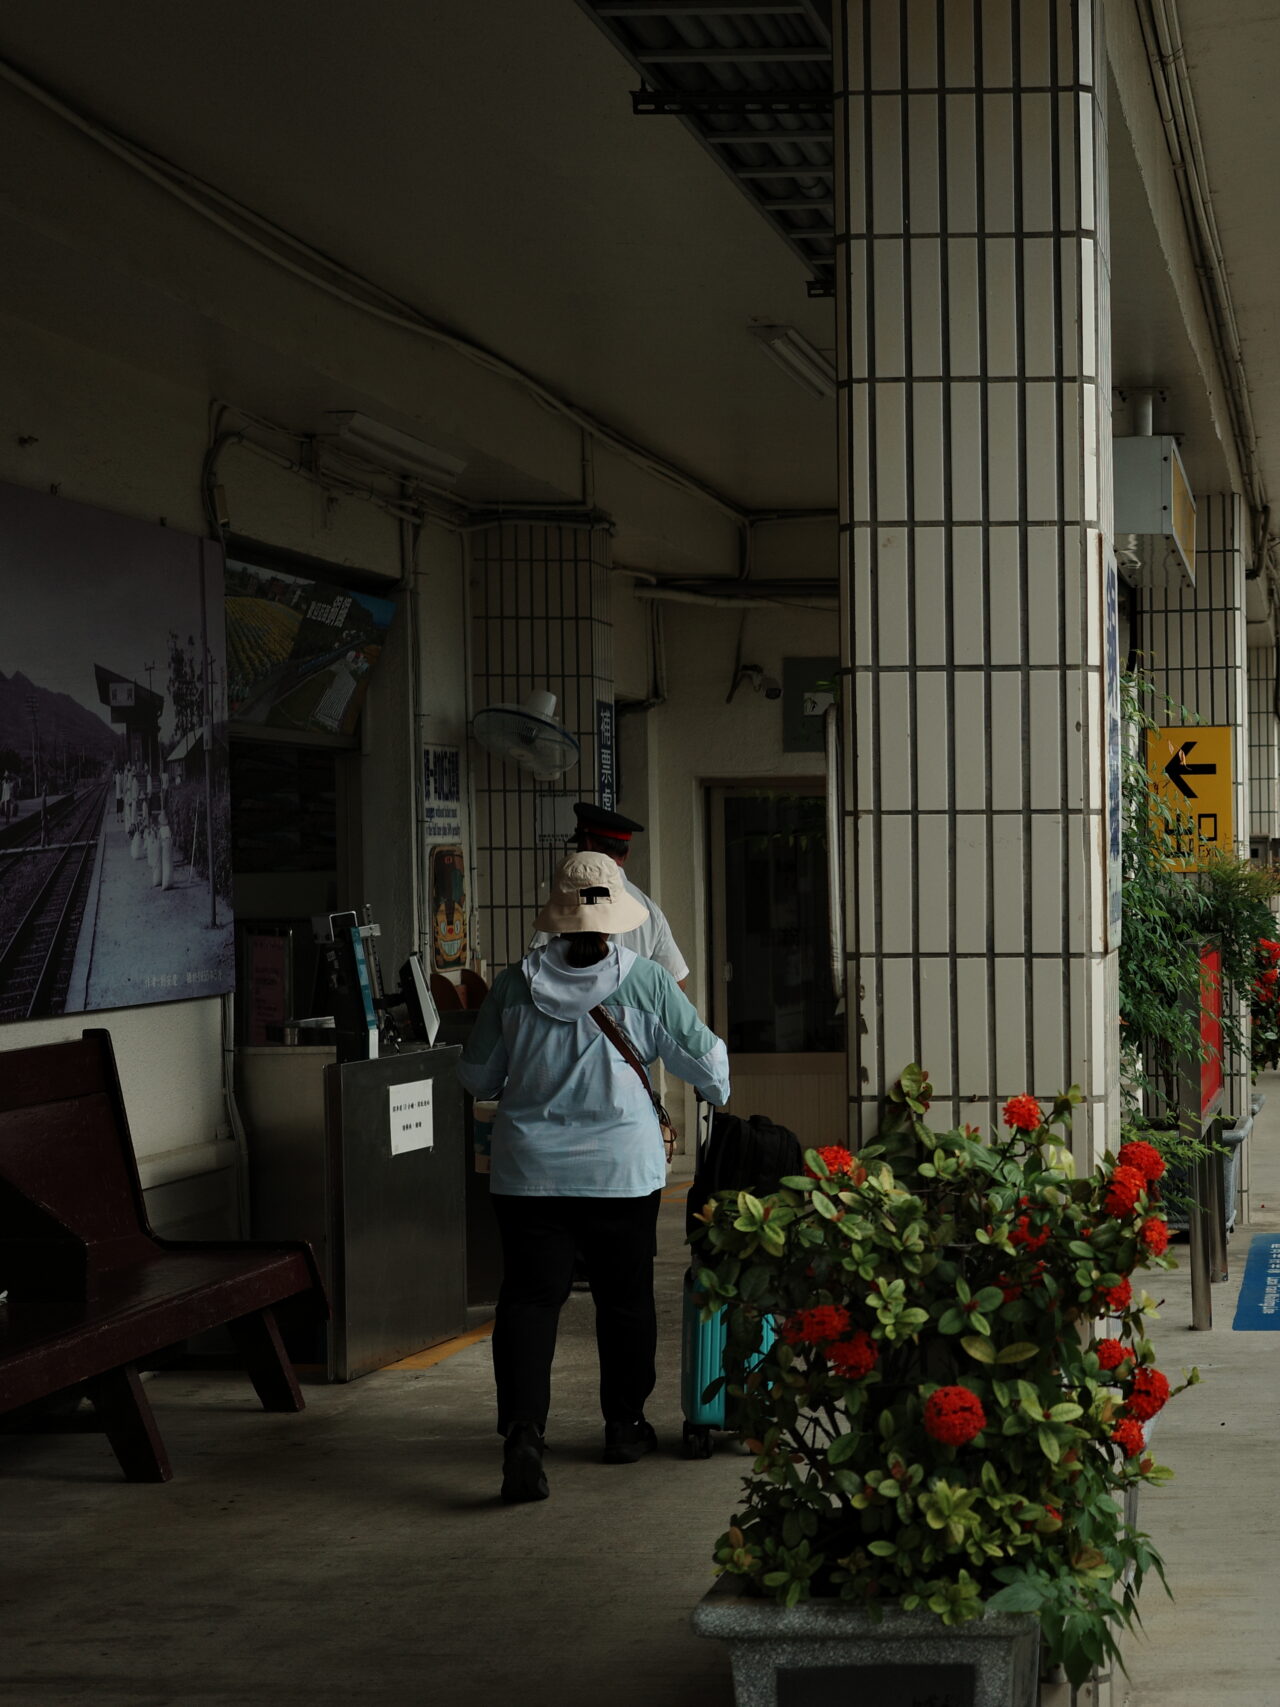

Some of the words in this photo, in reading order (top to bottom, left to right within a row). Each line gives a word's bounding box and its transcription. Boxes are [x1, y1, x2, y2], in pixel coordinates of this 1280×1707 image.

[600, 707, 613, 812] 補票處
[1198, 844, 1218, 858] Ext
